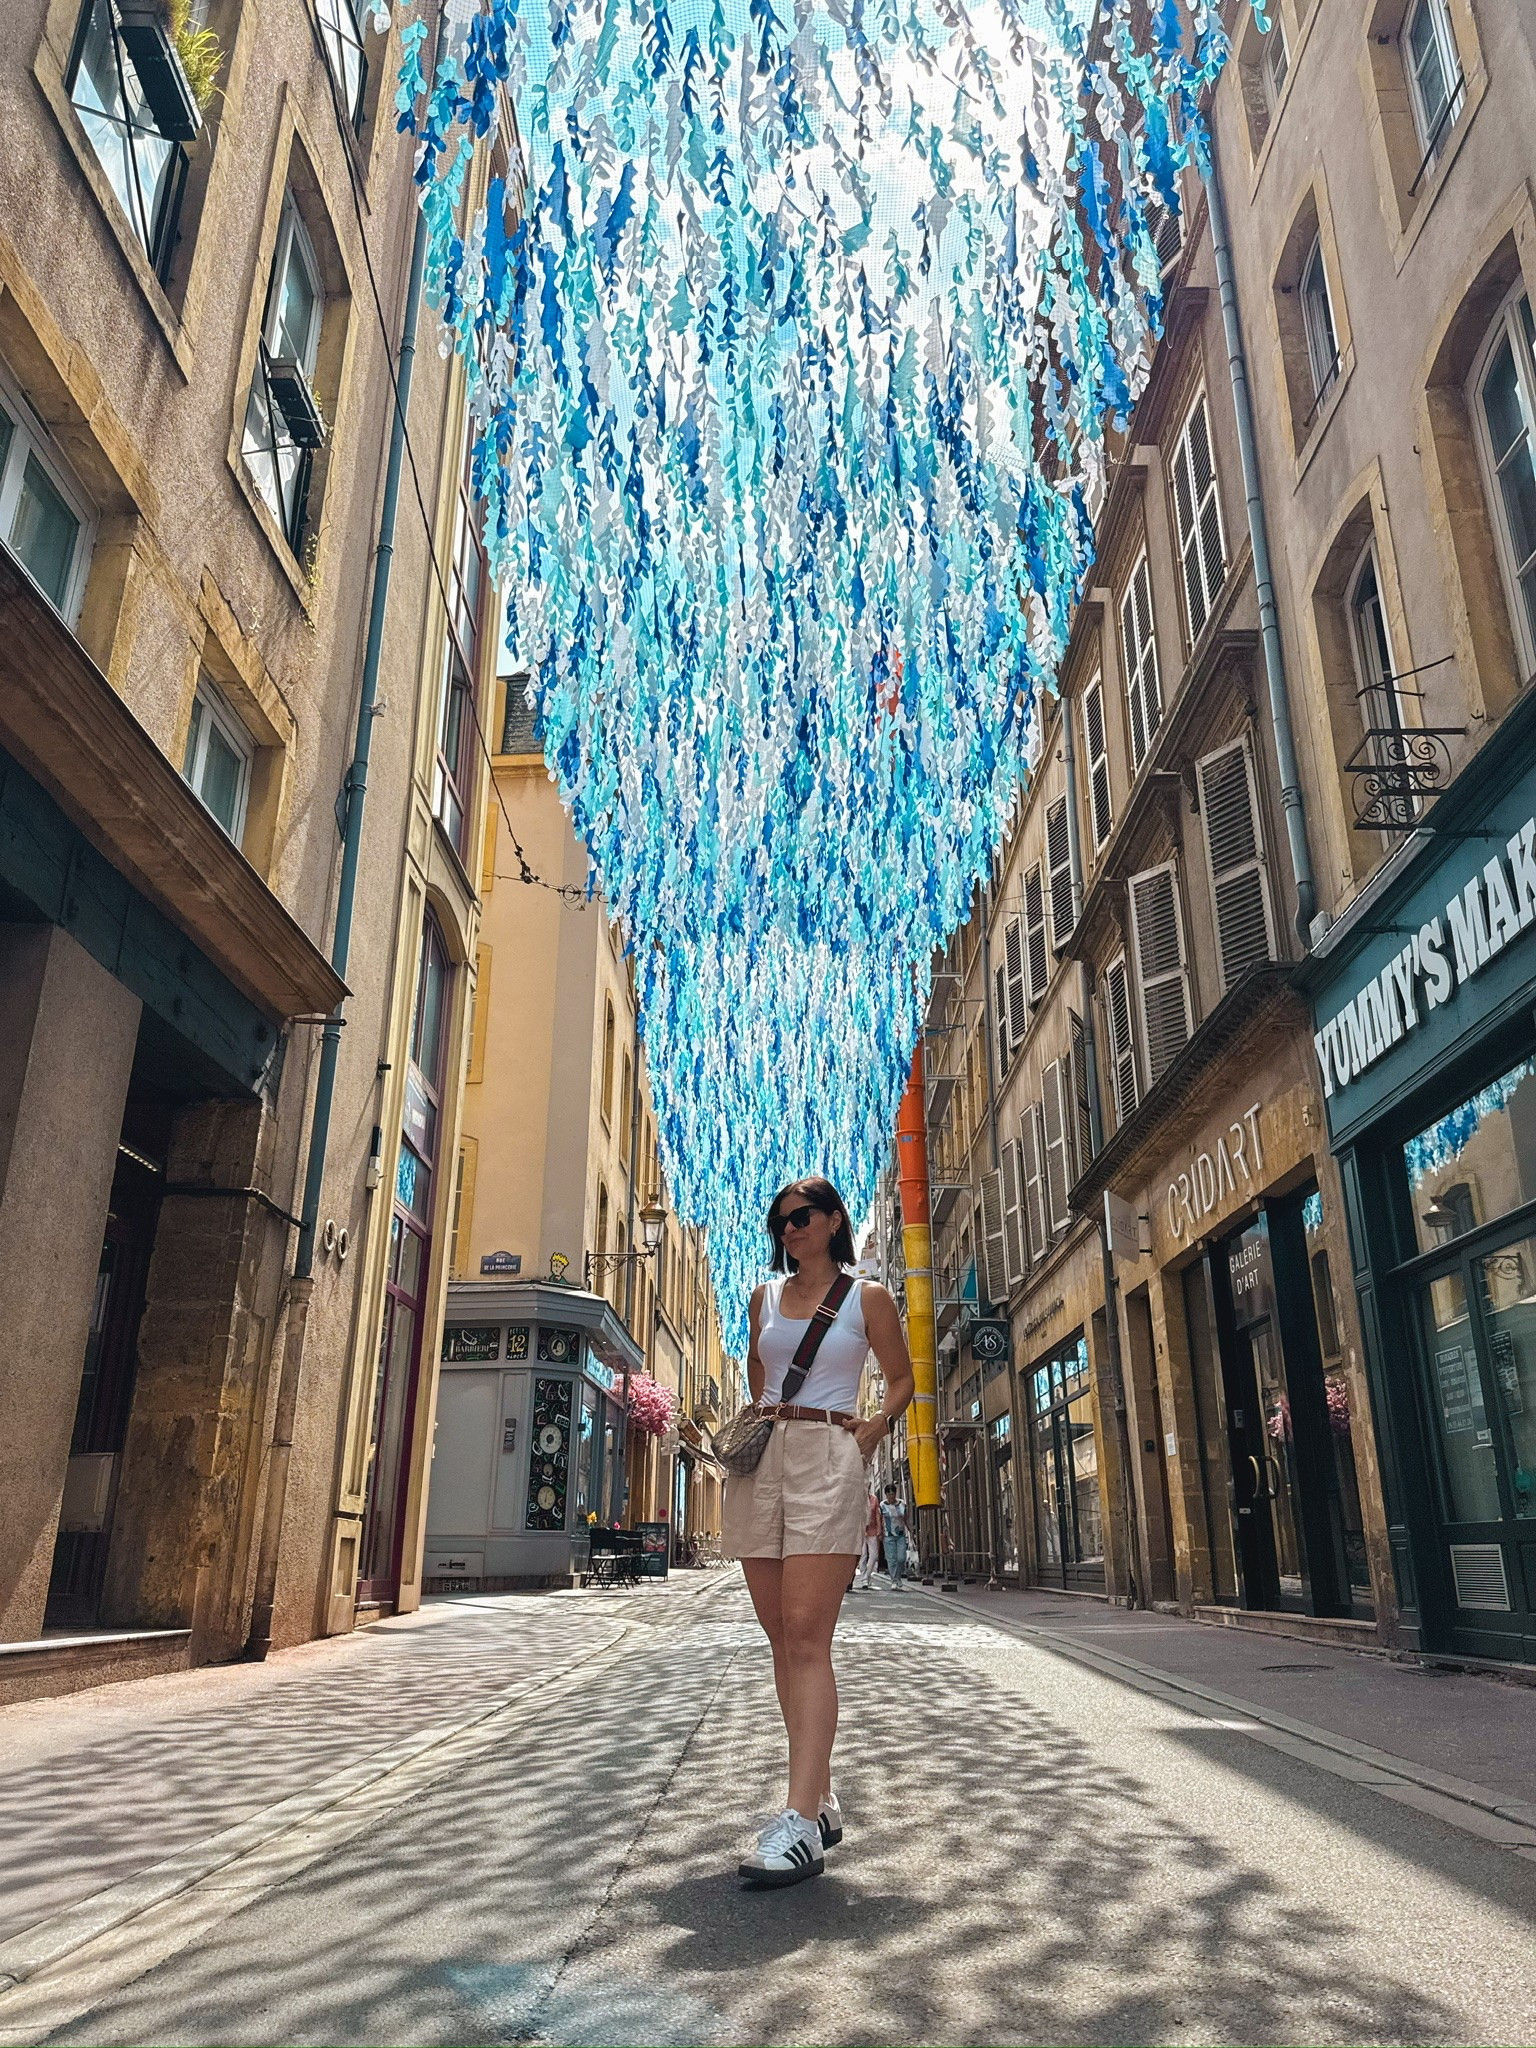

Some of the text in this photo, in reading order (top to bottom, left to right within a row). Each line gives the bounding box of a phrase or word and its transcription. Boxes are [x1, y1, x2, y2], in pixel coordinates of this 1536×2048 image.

[1314, 817, 1536, 1098] YUMMY'S MAK
[1168, 1102, 1263, 1238] CRIDART
[1229, 1241, 1262, 1274] GALERIE
[1236, 1268, 1259, 1295] D'ART
[509, 1334, 526, 1353] 12
